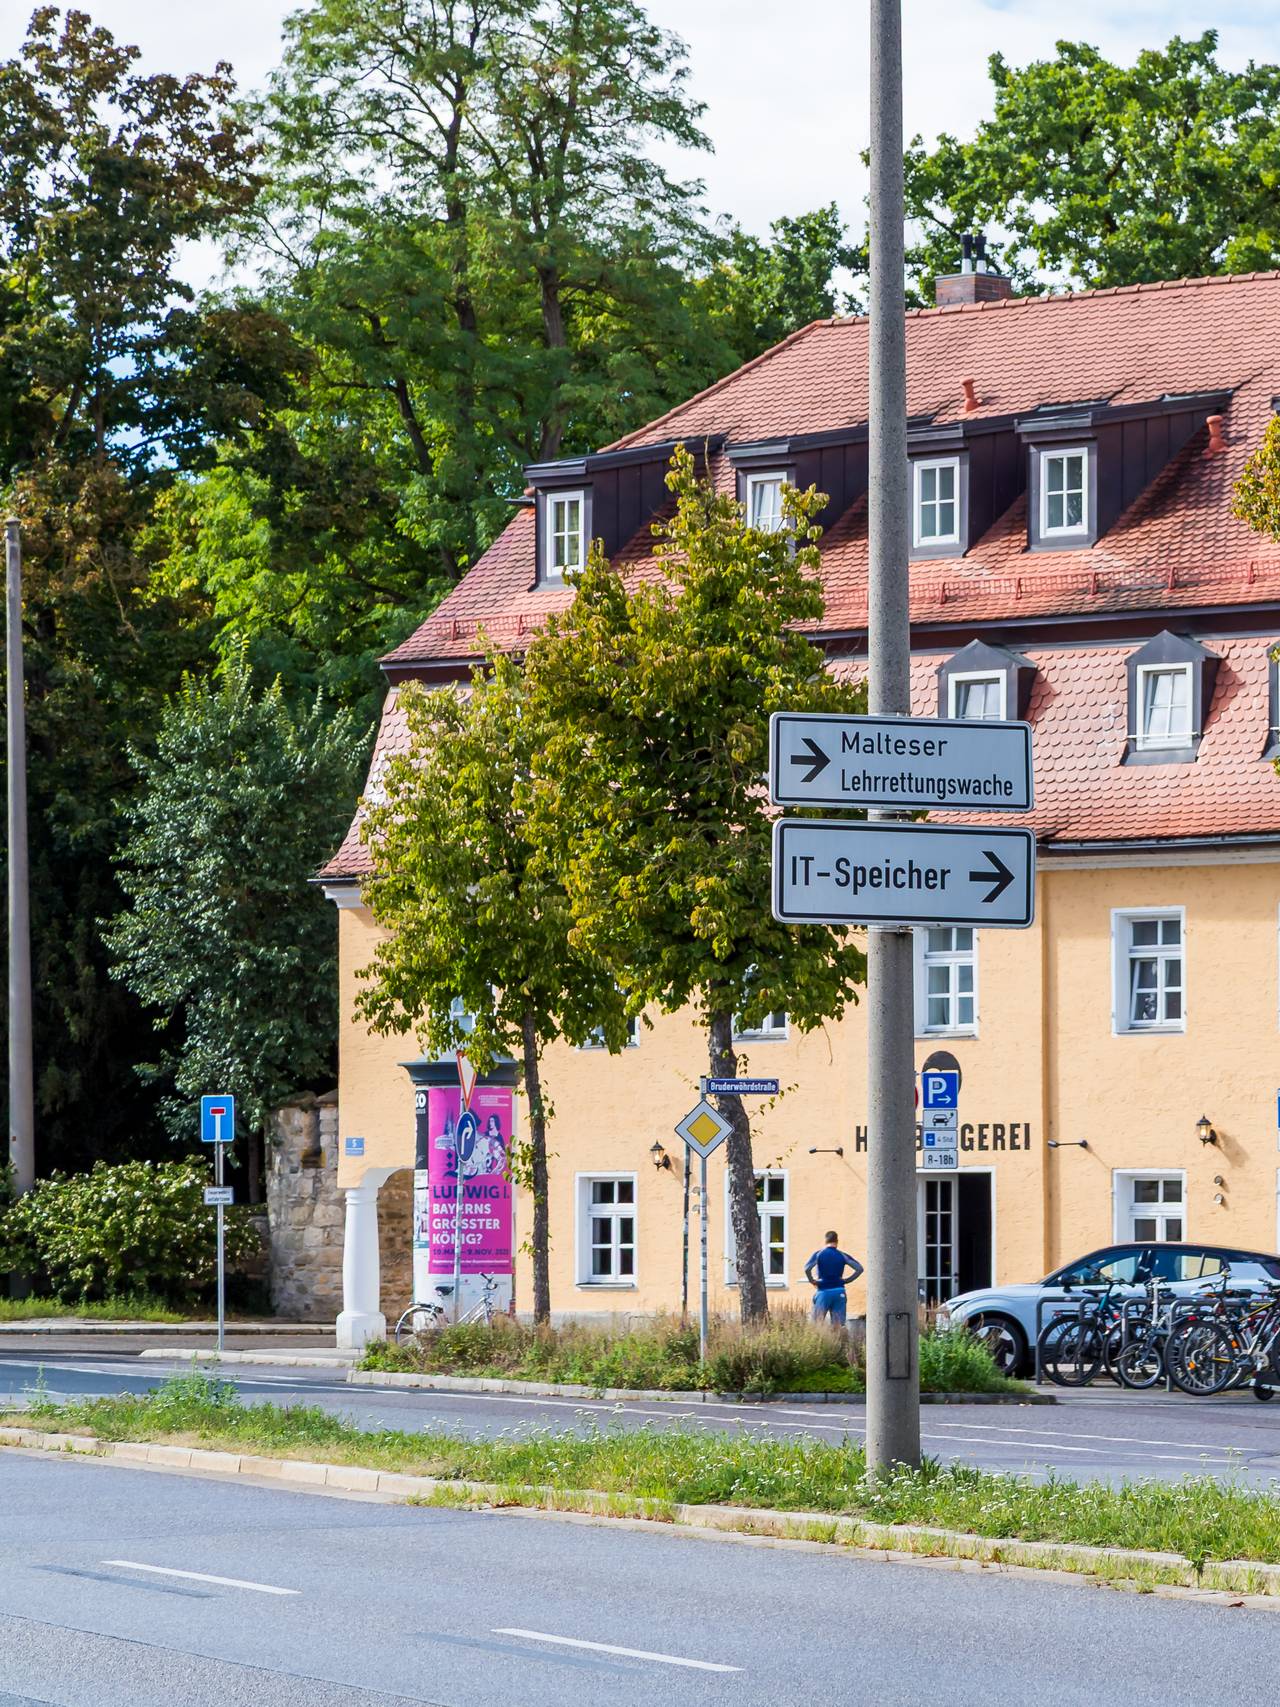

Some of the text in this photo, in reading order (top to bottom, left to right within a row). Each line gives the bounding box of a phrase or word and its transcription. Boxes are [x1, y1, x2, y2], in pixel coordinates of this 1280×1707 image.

[841, 731, 948, 757] Malteser
[841, 769, 1013, 800] Lehrrettungswache
[791, 856, 951, 895] IT-Speicher
[928, 1077, 947, 1104] P
[432, 1203, 492, 1215] BAYRNS
